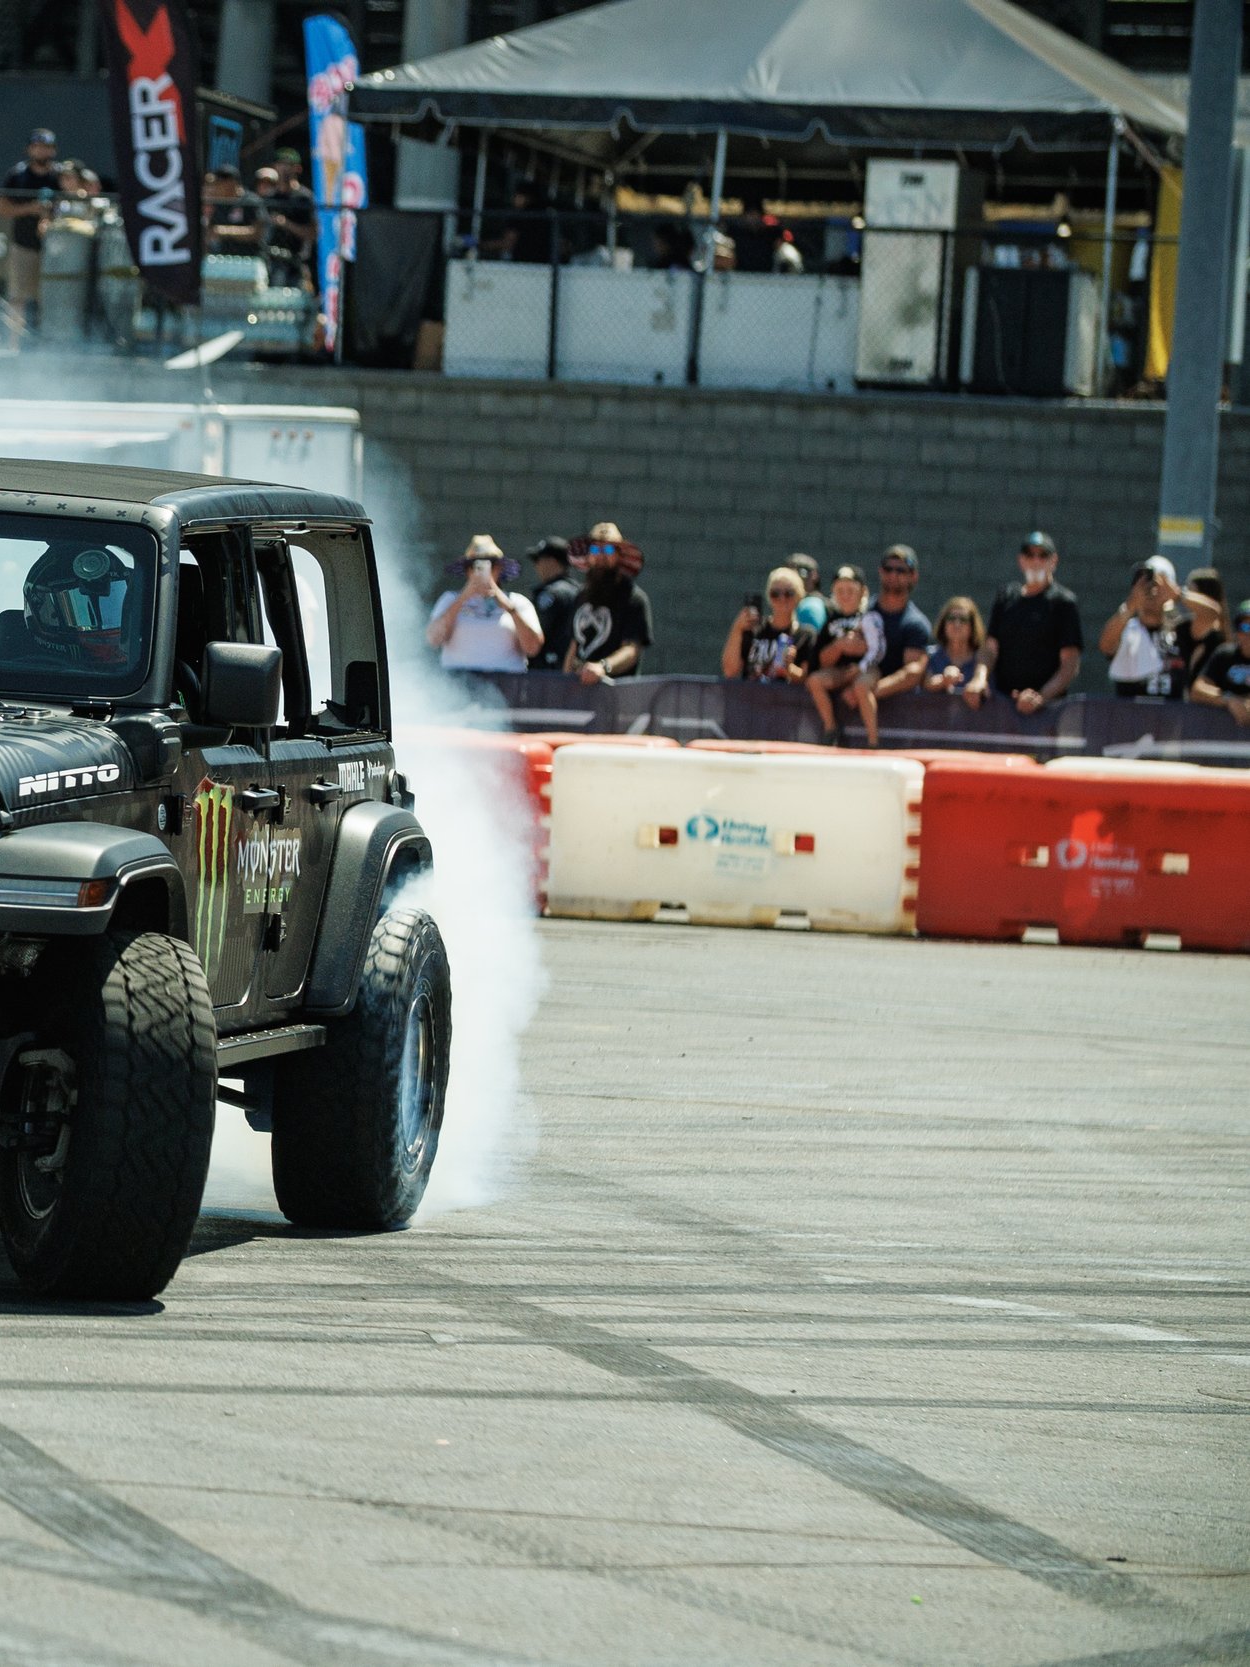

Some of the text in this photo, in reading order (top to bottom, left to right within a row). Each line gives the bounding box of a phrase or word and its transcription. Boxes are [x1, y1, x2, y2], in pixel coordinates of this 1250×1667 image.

[18, 763, 120, 797] NITTO
[338, 760, 365, 792] MAHLE
[237, 830, 301, 883] MONSTER
[245, 887, 291, 904] ENERGY
